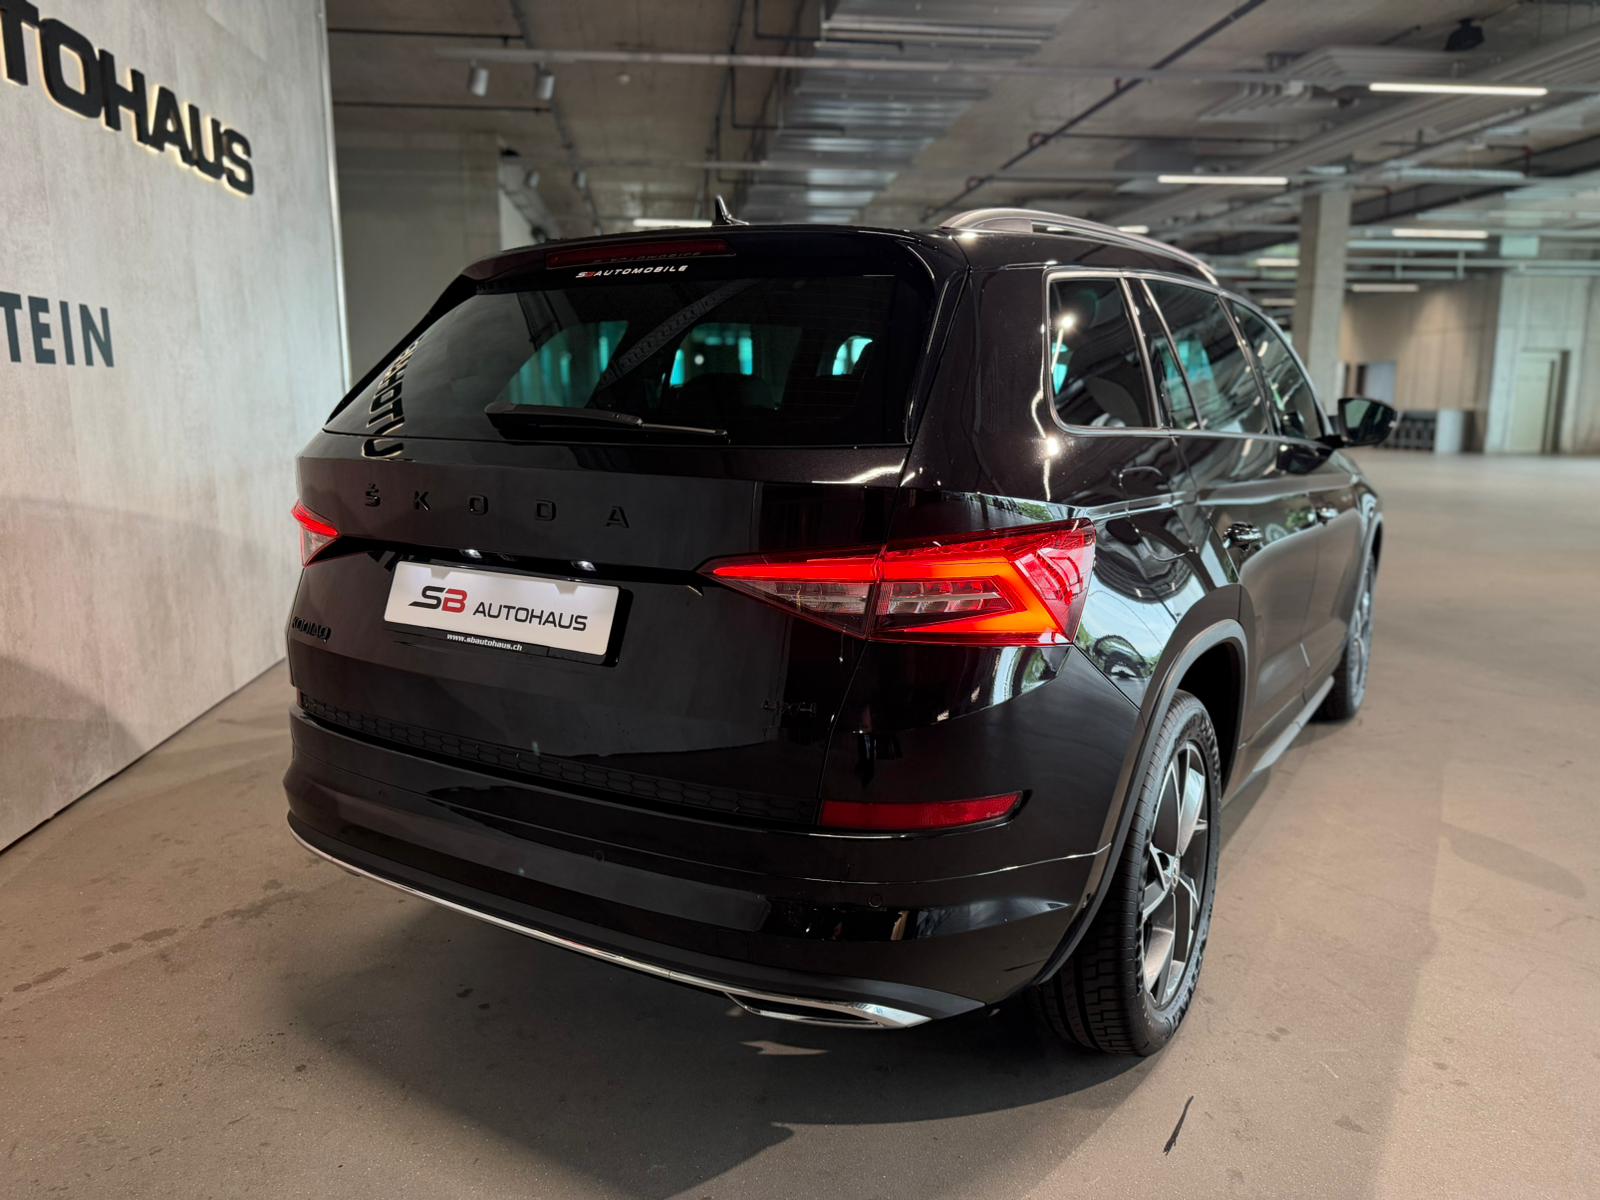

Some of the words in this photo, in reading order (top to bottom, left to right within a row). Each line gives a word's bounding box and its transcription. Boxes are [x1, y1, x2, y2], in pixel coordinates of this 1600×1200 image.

[408, 585, 468, 614] SB
[472, 601, 589, 632] AUTOHAUS
[446, 632, 523, 652] www.sbautohaus.ch
